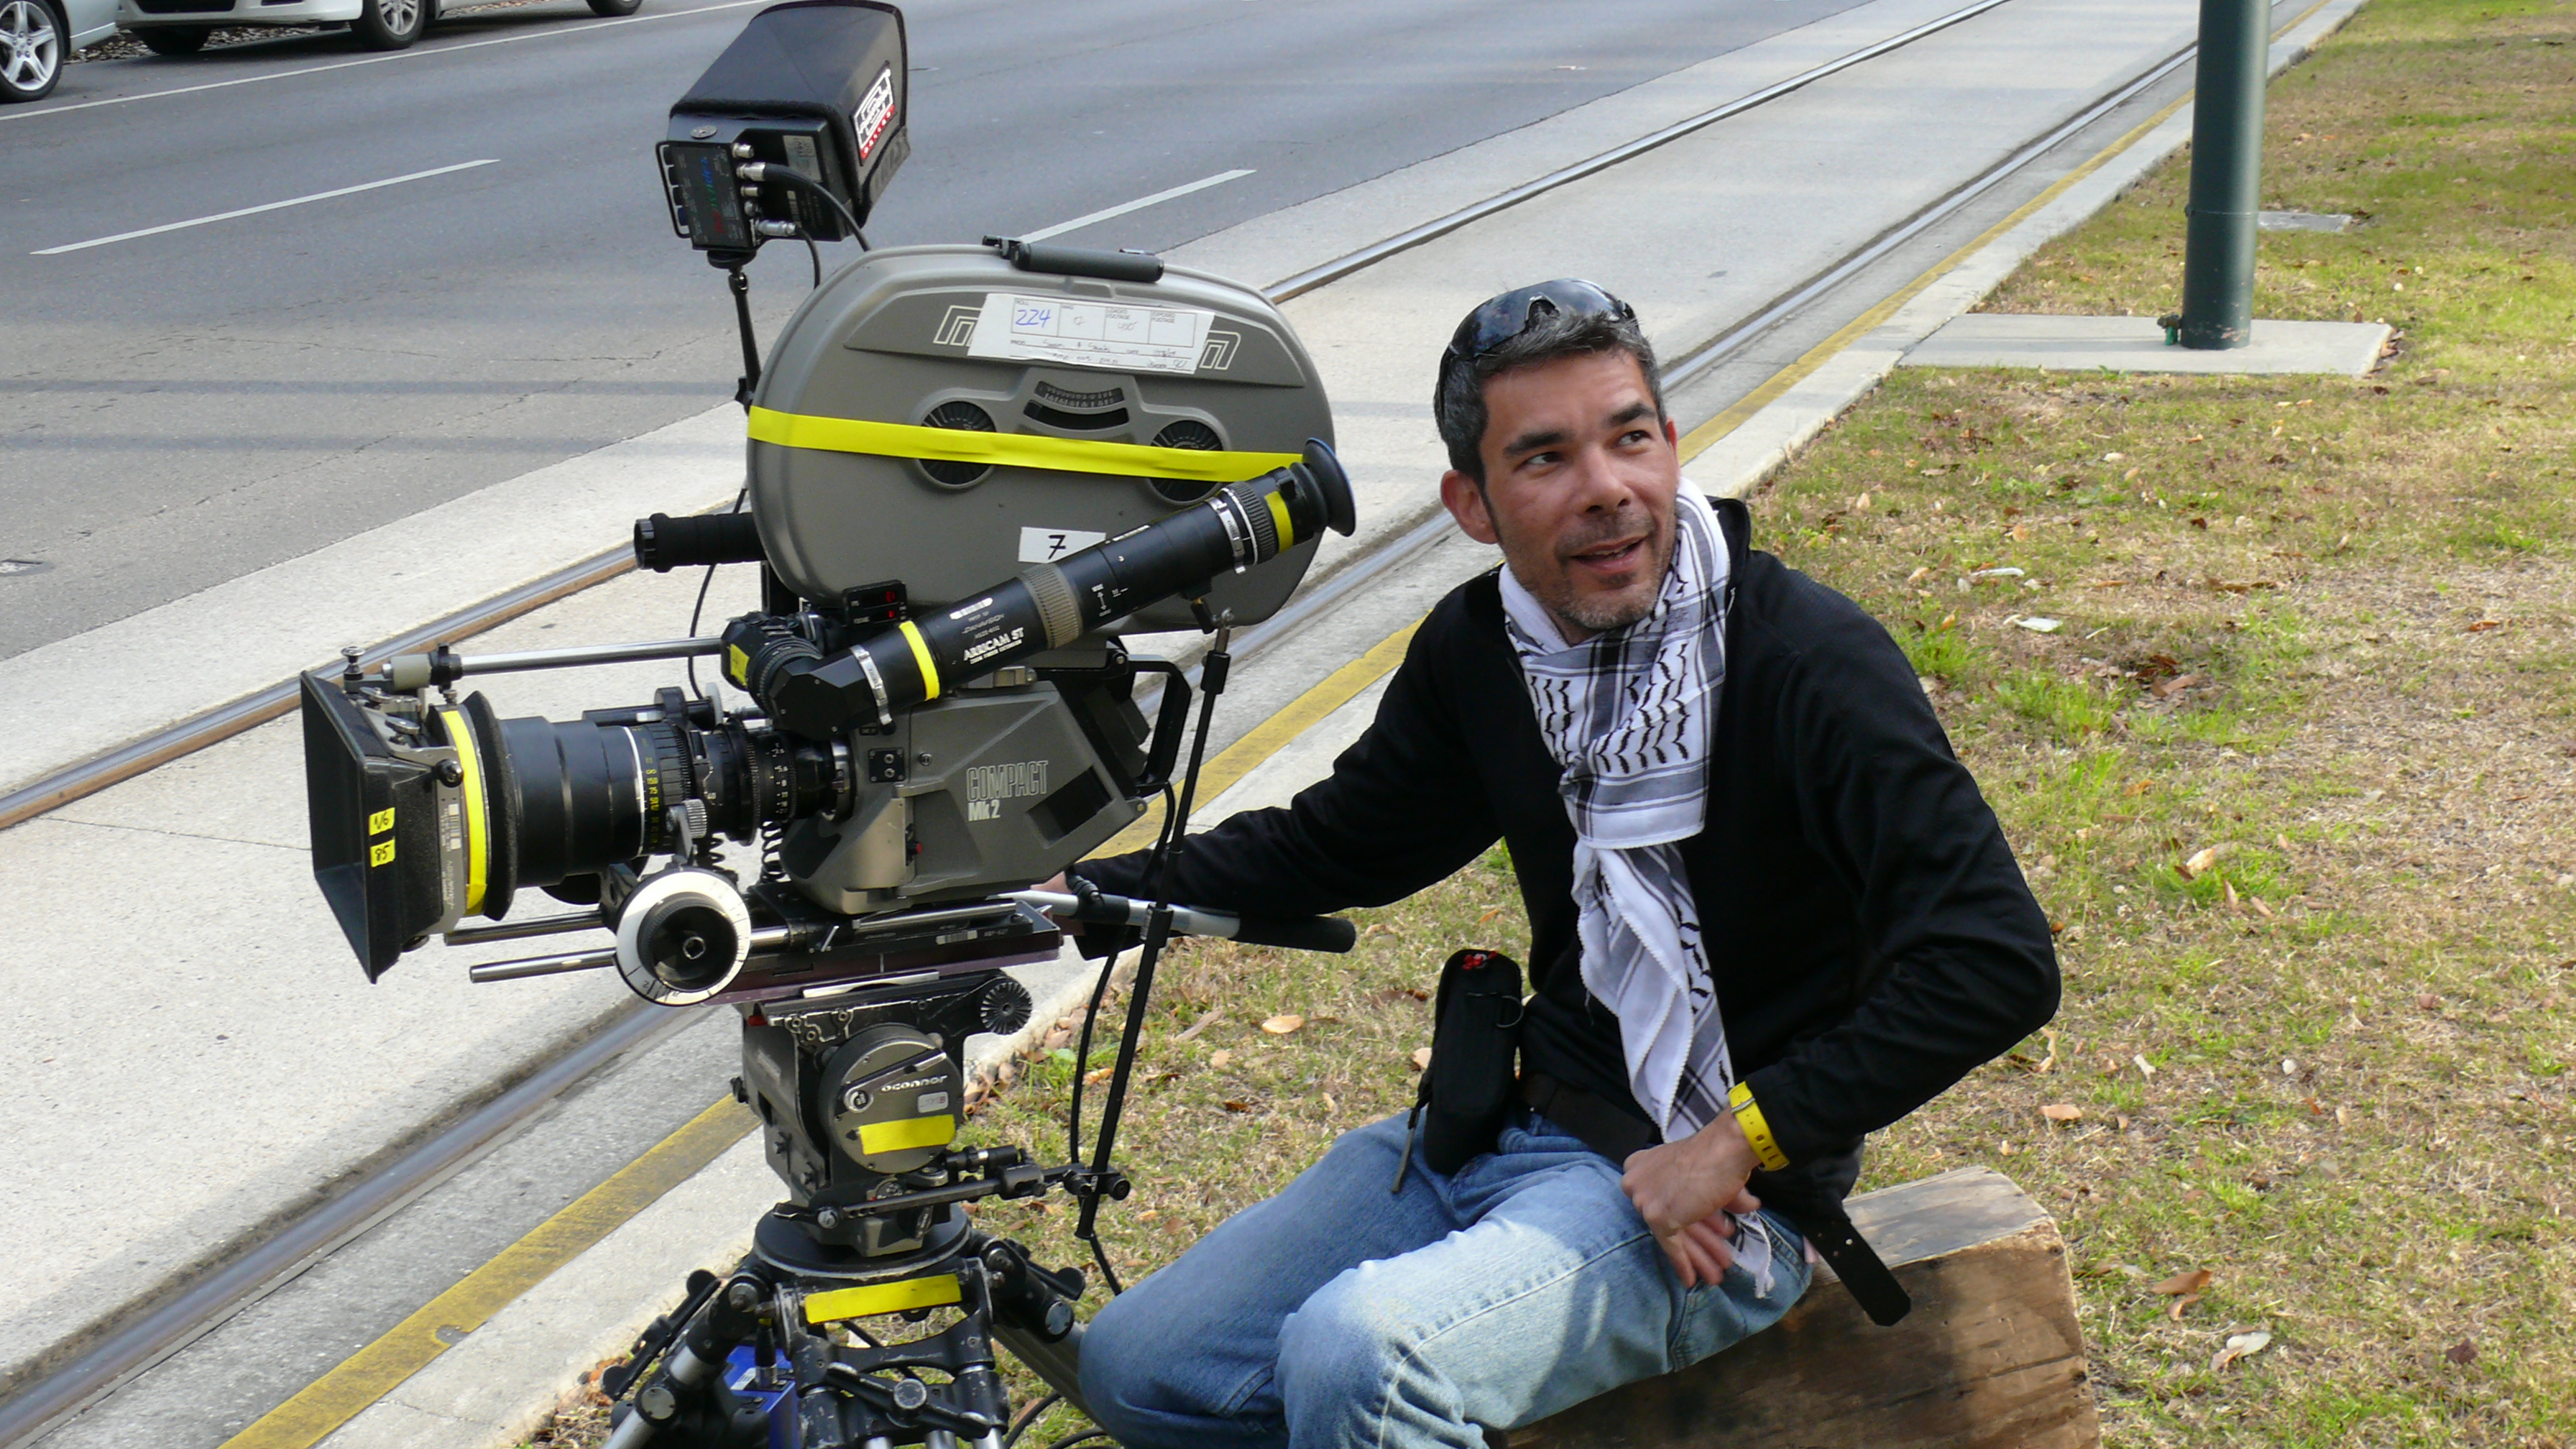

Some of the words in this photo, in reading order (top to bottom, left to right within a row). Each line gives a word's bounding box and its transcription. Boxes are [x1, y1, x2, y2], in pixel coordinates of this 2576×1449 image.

[1016, 308, 1052, 328] 224
[1048, 534, 1067, 561] 7
[963, 632, 1011, 662] ARRICAM
[1011, 626, 1024, 641] ST
[966, 760, 1049, 802] COMPACT
